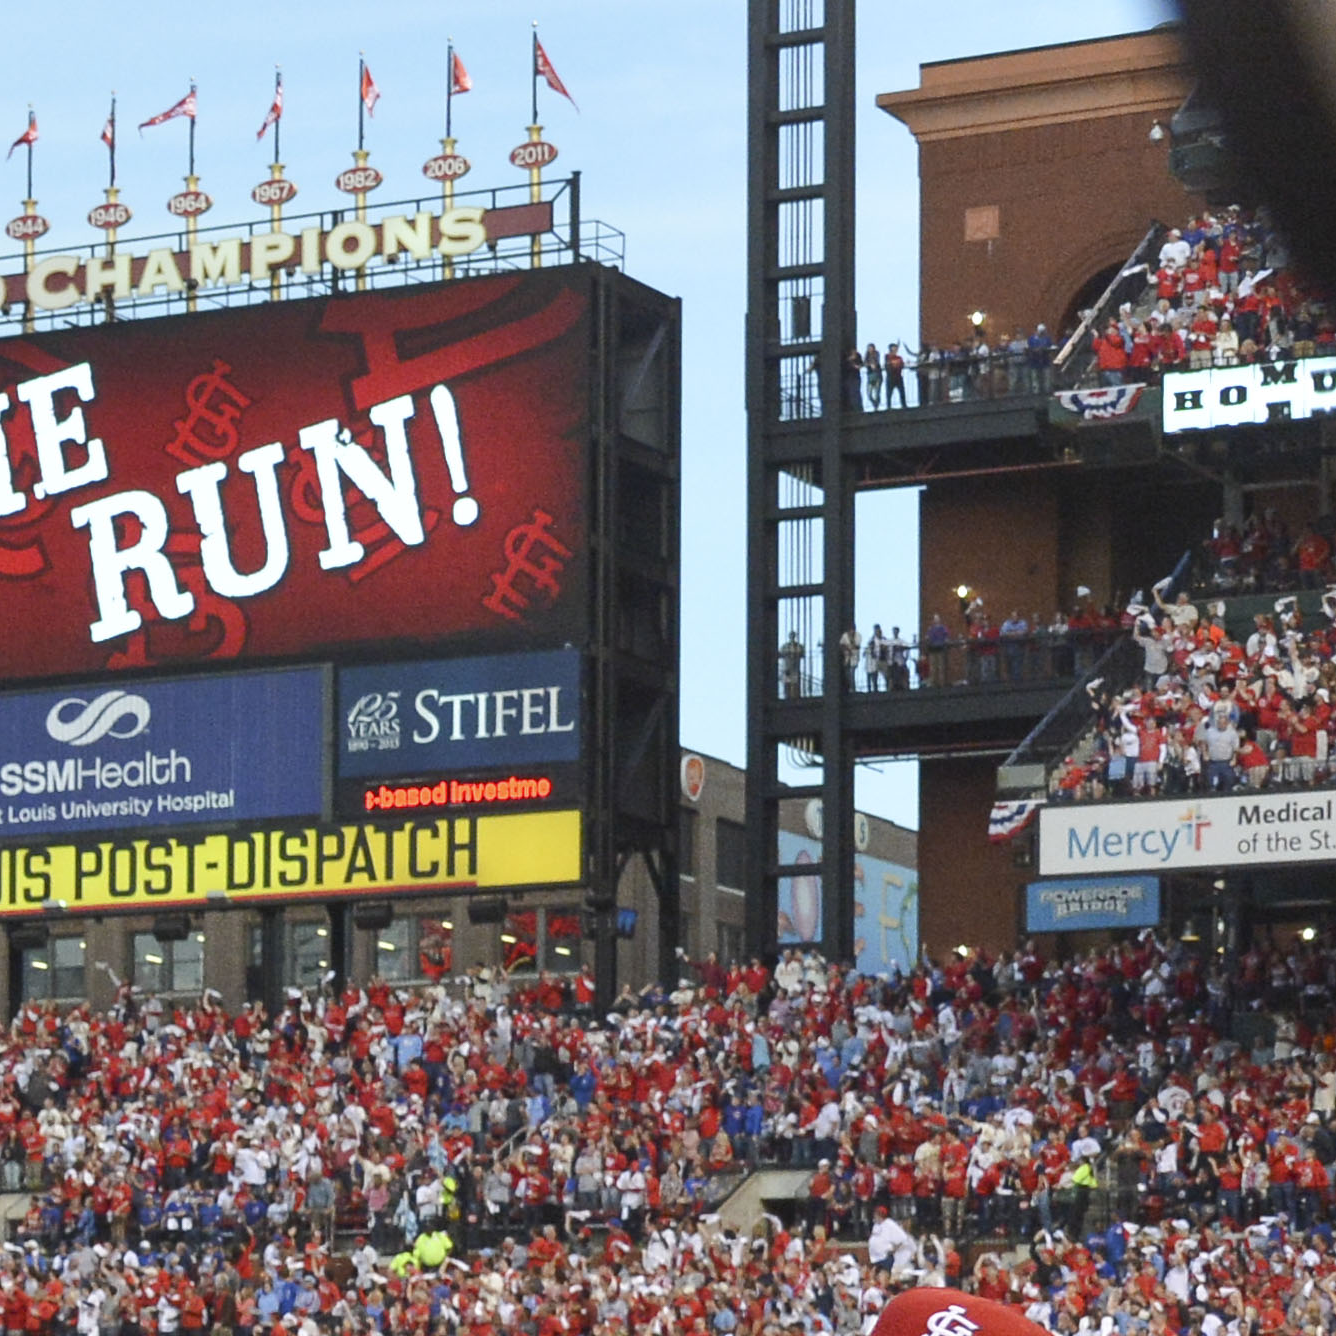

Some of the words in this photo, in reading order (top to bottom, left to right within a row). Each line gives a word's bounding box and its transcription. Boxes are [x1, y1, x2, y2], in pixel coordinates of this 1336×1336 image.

[513, 143, 551, 165] 2011
[426, 157, 465, 177] 2006
[338, 169, 377, 190] 1982
[254, 183, 291, 203] 1967
[91, 205, 128, 226] 1946
[170, 195, 207, 216] 1964
[8, 217, 45, 236] 1944
[26, 206, 487, 311] CHAMPIONS
[70, 384, 481, 645] RUN!
[412, 685, 575, 745] STIFEL
[347, 719, 401, 739] YEARS
[0, 748, 192, 797] SSMHealth
[8, 802, 57, 825] Louis
[61, 797, 153, 823] University
[157, 789, 235, 815] Hospital
[1237, 799, 1332, 826] Medical
[1067, 824, 1181, 863] Mercy
[1237, 833, 1260, 855] of
[1266, 831, 1303, 852] the
[74, 815, 478, 901] POST-DISPATCH
